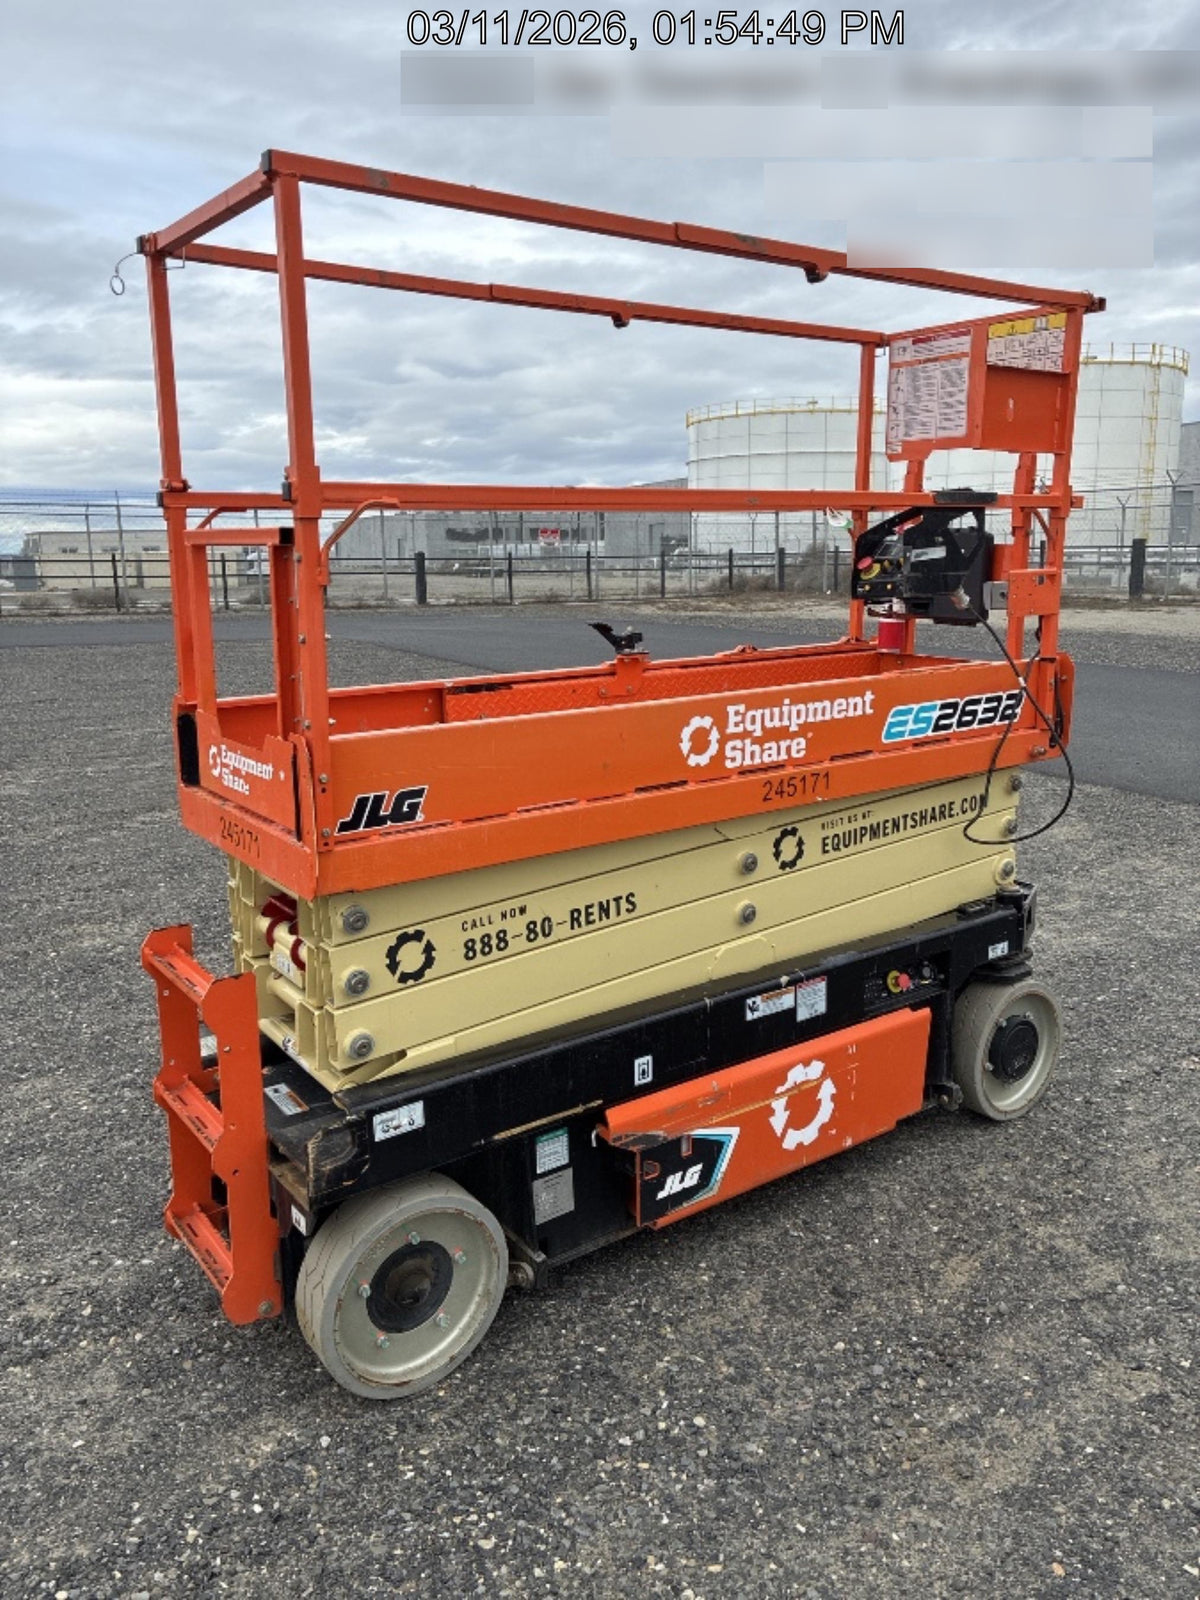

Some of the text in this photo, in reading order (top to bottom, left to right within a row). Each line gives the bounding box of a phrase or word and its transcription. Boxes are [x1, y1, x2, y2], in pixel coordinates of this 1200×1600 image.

[726, 690, 875, 736] Equipment
[882, 690, 1026, 743] ES2632
[220, 744, 274, 781] Equipment
[725, 736, 806, 769] Share
[222, 767, 250, 796] Share
[762, 771, 830, 802] 245171
[334, 784, 428, 836] JLG
[821, 817, 843, 831] VISIT
[848, 814, 858, 824] US
[219, 816, 260, 859] 245171
[461, 904, 528, 932] CALL NOW
[463, 891, 638, 961] 888-80-RENTS
[655, 1162, 704, 1201] JLG
